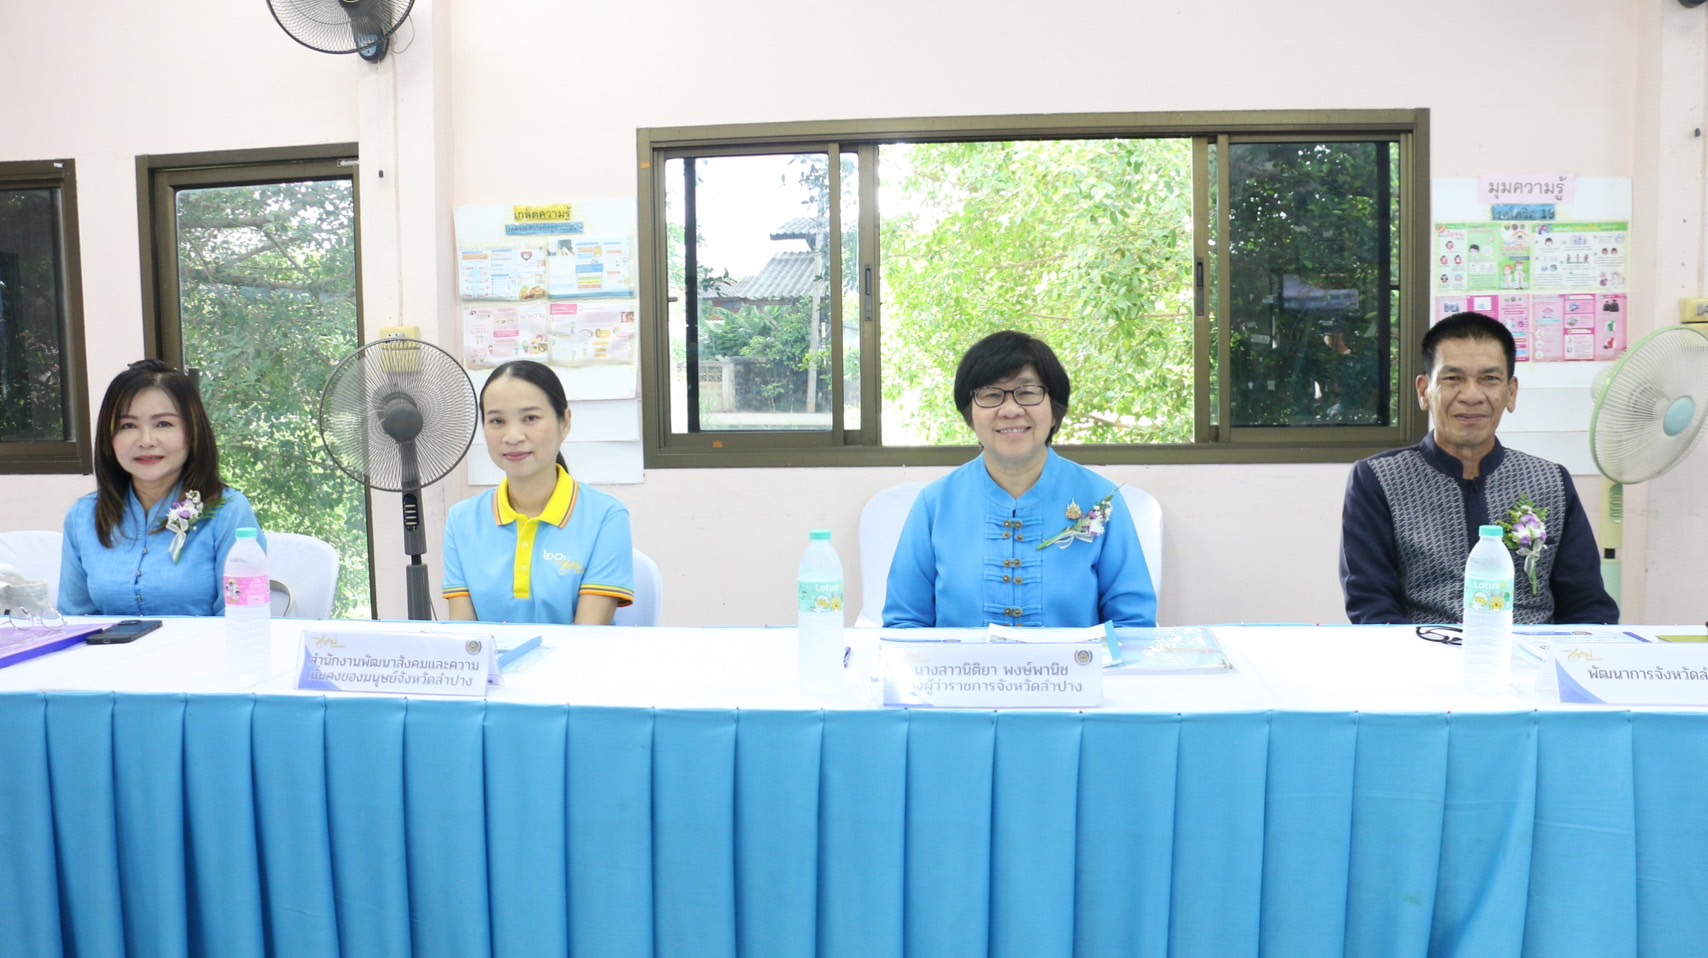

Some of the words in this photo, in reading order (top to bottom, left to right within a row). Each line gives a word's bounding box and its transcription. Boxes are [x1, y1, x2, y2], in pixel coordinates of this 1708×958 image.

[1488, 176, 1567, 201] มุมความรู้
[310, 652, 480, 672] สำนักงานพัฒนาสังคมและความ
[1003, 661, 1069, 676] พงษ์พานิช
[911, 678, 1083, 696] งผู้ว่าราชการจังหวัดลำปาง
